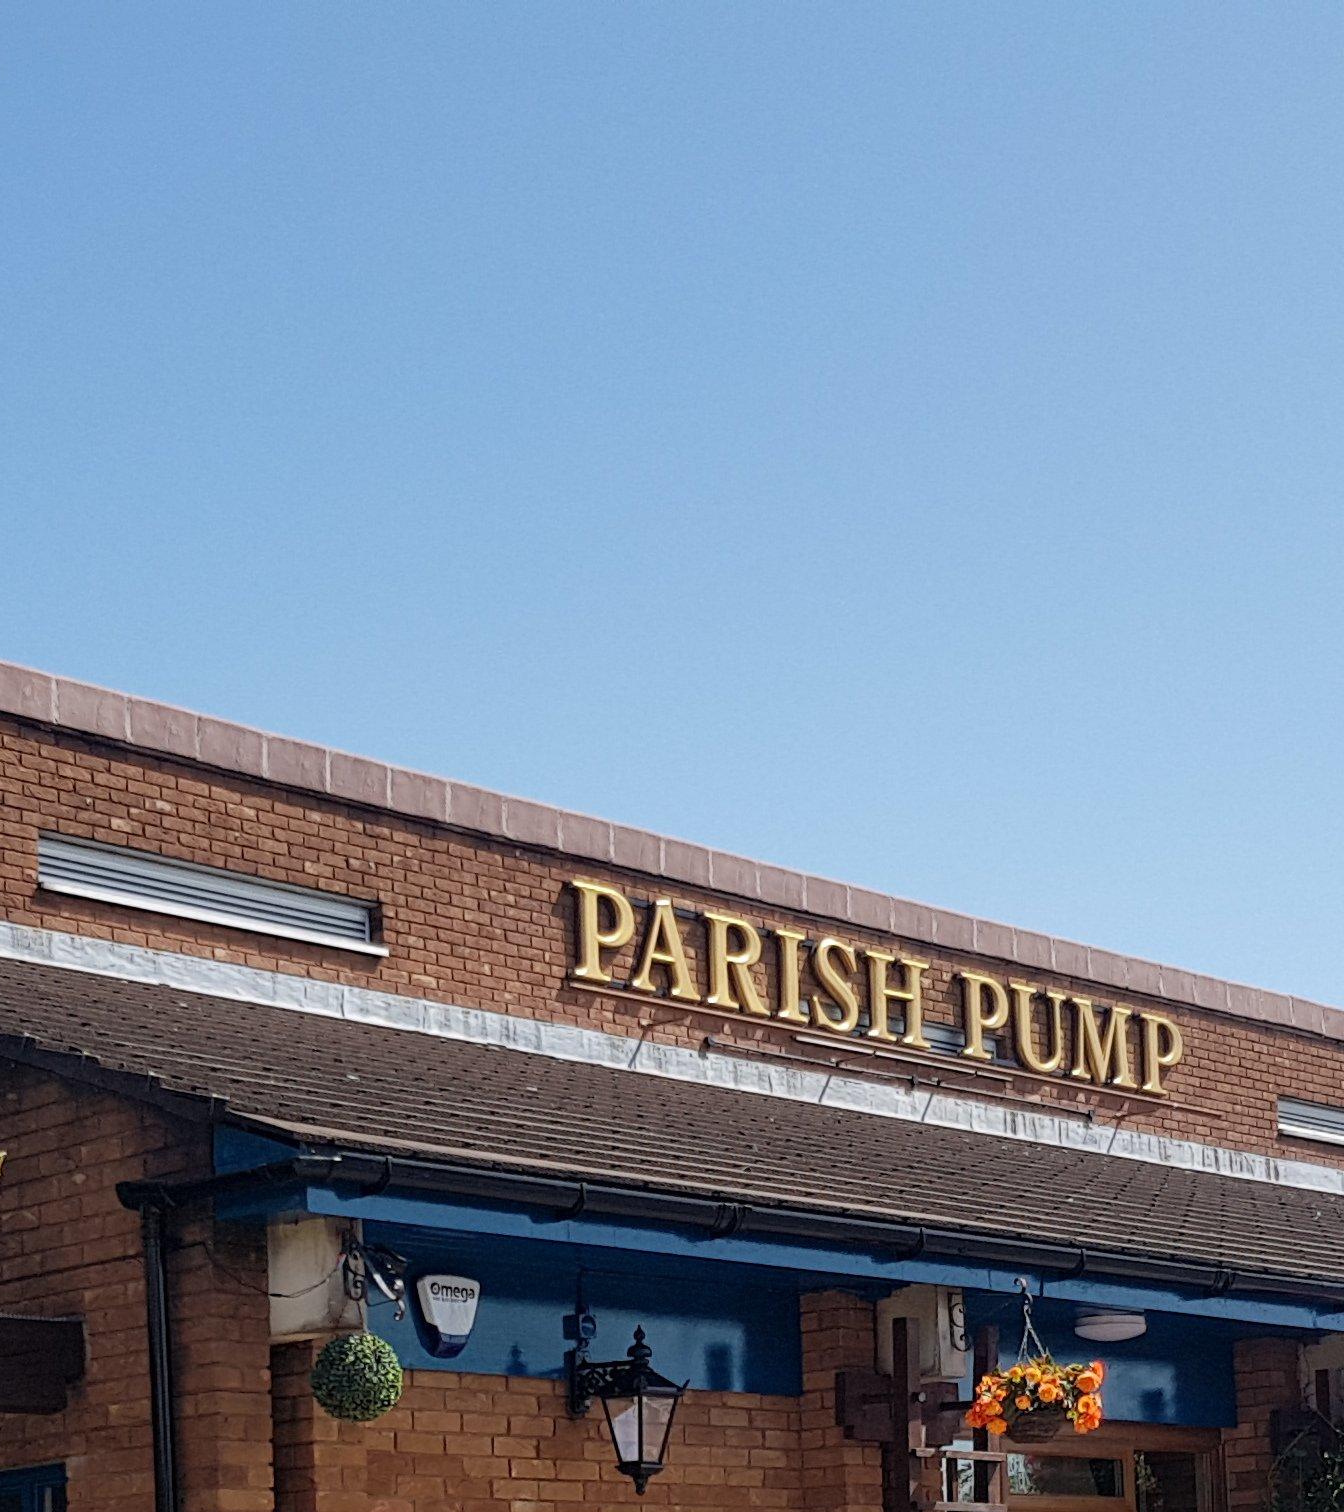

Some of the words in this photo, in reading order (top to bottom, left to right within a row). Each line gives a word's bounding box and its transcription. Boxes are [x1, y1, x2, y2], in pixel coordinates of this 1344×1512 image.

[570, 879, 931, 1049] PARISH
[959, 972, 1184, 1095] PUMP
[430, 1282, 476, 1302] Omega
